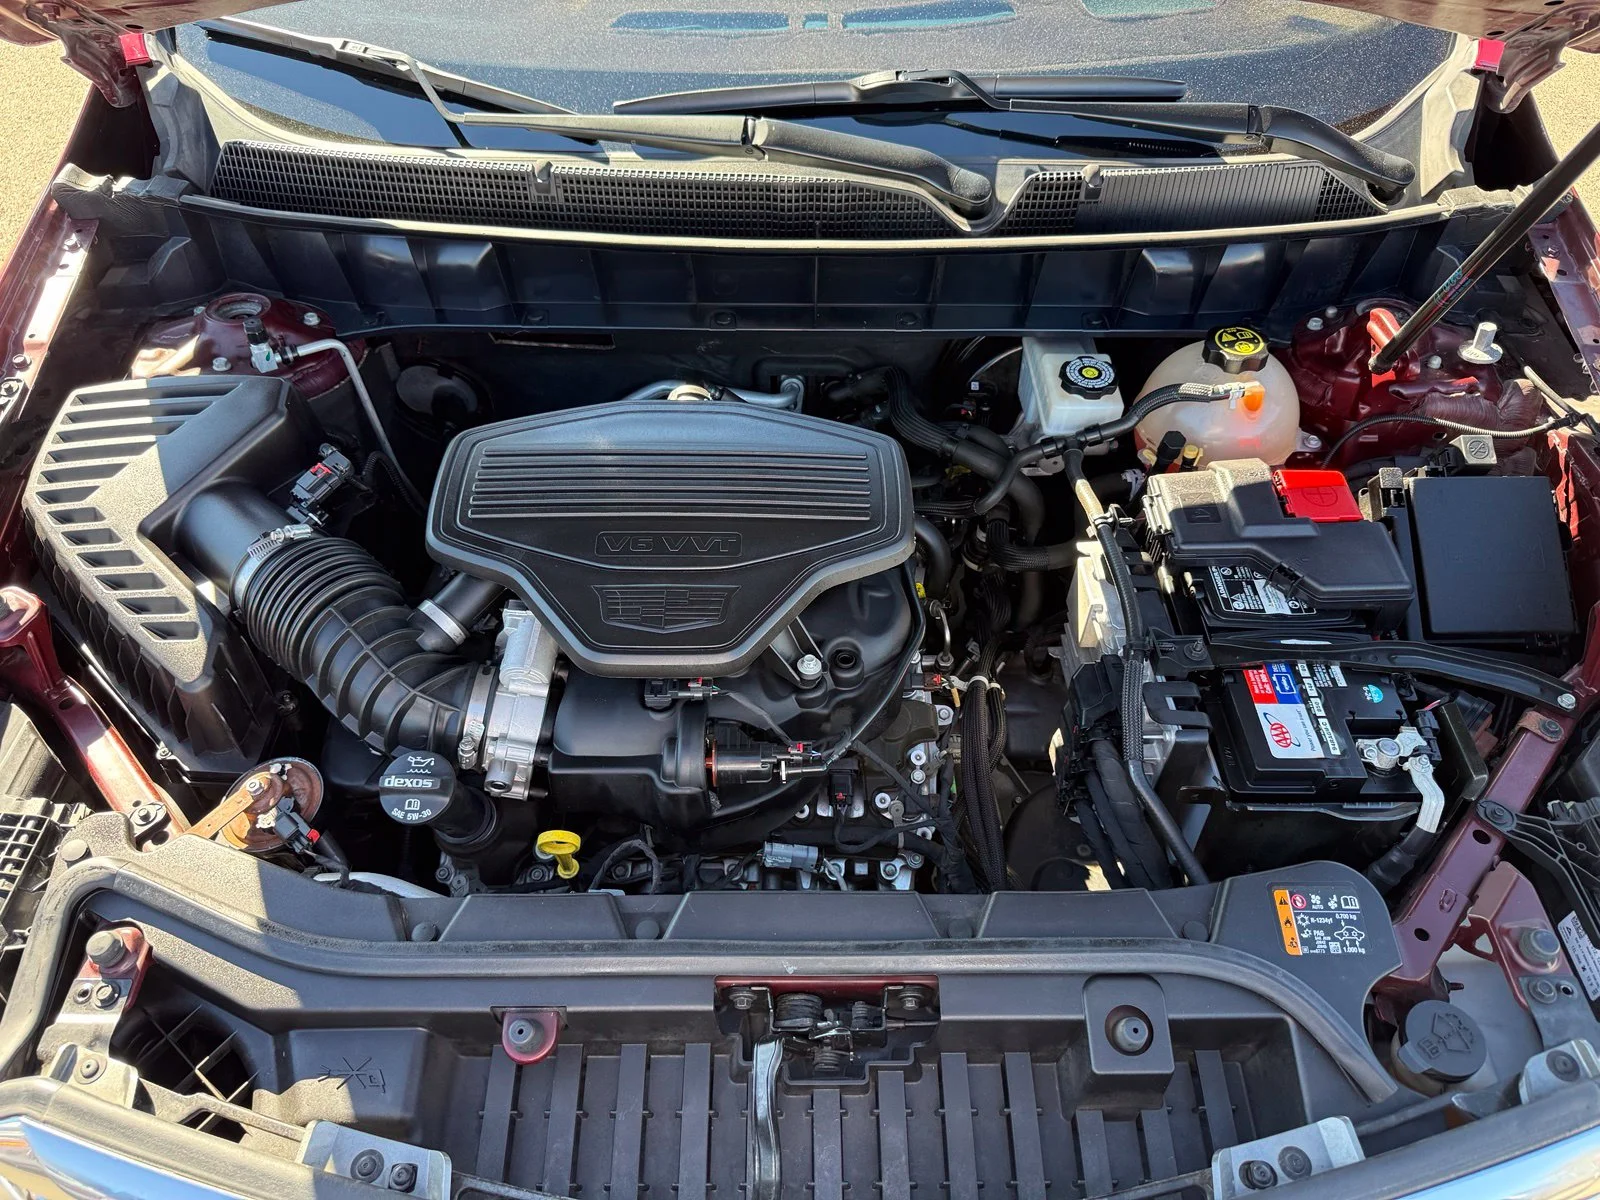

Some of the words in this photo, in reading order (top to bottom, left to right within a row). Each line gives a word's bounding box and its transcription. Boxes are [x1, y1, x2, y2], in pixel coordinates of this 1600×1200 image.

[603, 536, 653, 552] V6
[661, 536, 737, 552] VVT
[1271, 724, 1291, 747] AAA
[384, 775, 435, 788] dexos
[391, 807, 406, 819] SAE
[406, 808, 432, 821] 5W-30
